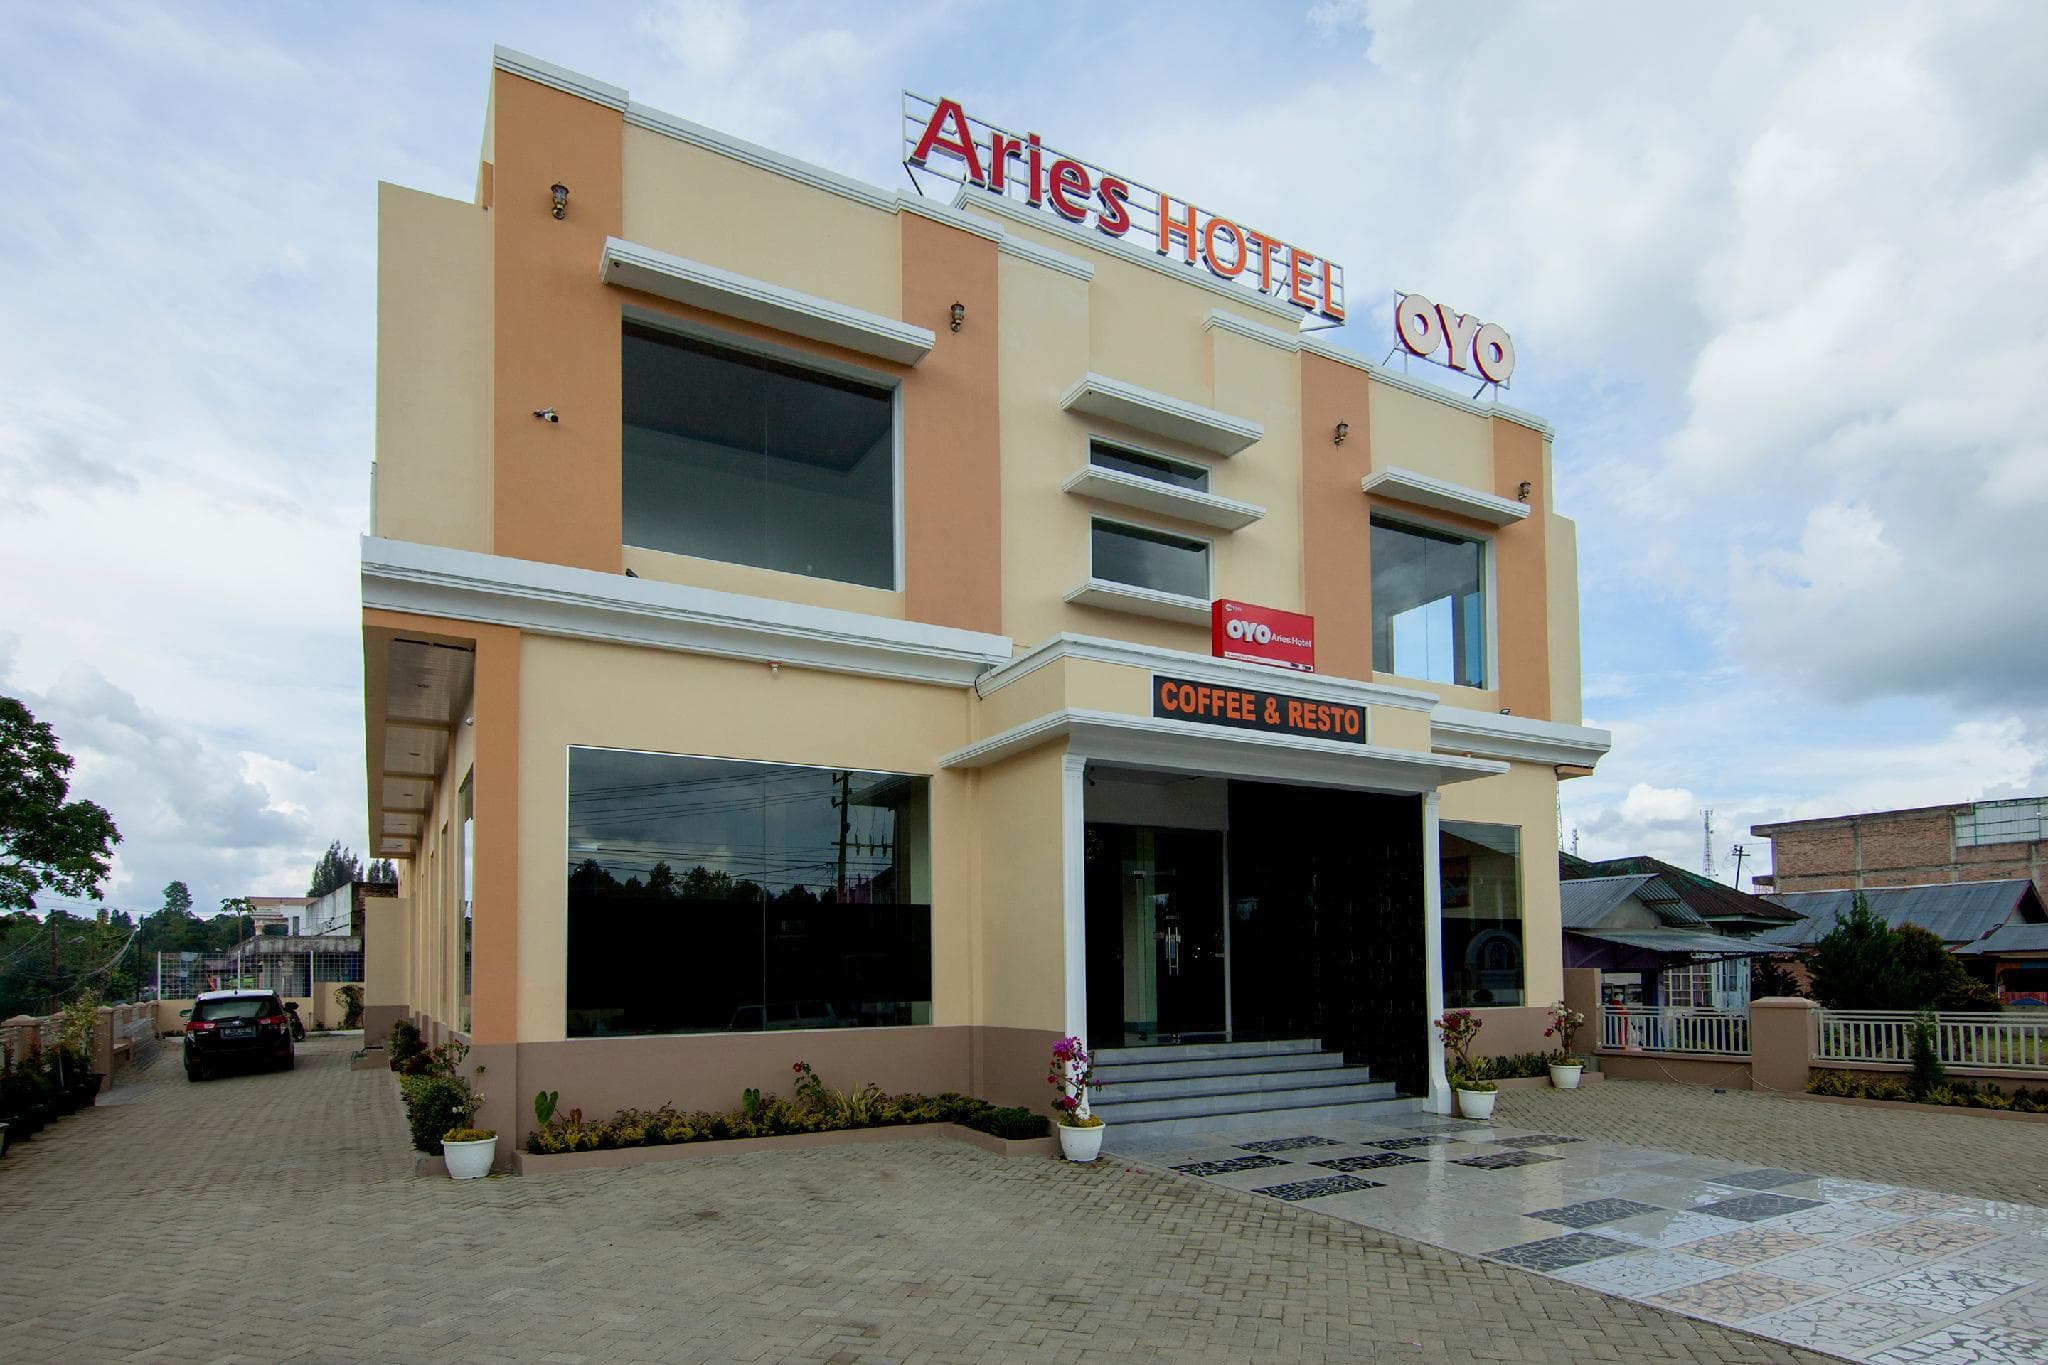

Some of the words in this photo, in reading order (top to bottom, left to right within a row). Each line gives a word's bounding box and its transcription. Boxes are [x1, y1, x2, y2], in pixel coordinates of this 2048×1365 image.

[908, 97, 1131, 237] Aries
[1157, 193, 1345, 321] HOTEL
[1396, 294, 1515, 383] OYO
[1226, 619, 1271, 644] OYO
[1271, 633, 1291, 644] Aries
[1292, 636, 1312, 648] Hotel
[1160, 682, 1256, 721] COFFEE
[1263, 697, 1280, 725] &
[1288, 700, 1359, 735] RESTO
